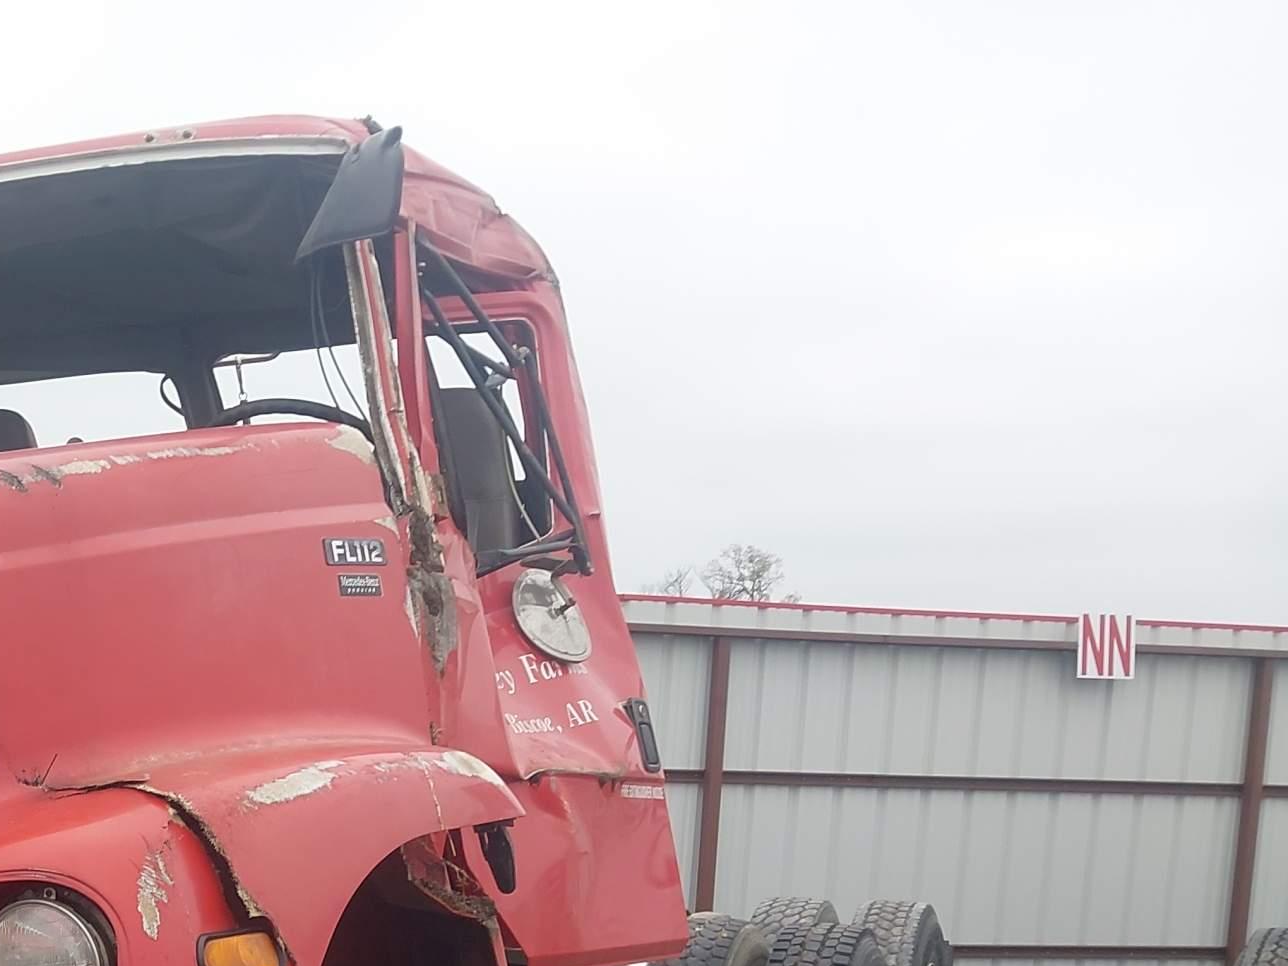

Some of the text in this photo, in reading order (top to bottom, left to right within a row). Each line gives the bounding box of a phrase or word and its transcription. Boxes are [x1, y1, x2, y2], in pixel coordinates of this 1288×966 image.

[331, 539, 383, 563] FL112
[1081, 613, 1132, 677] NN
[566, 699, 599, 728] AR
